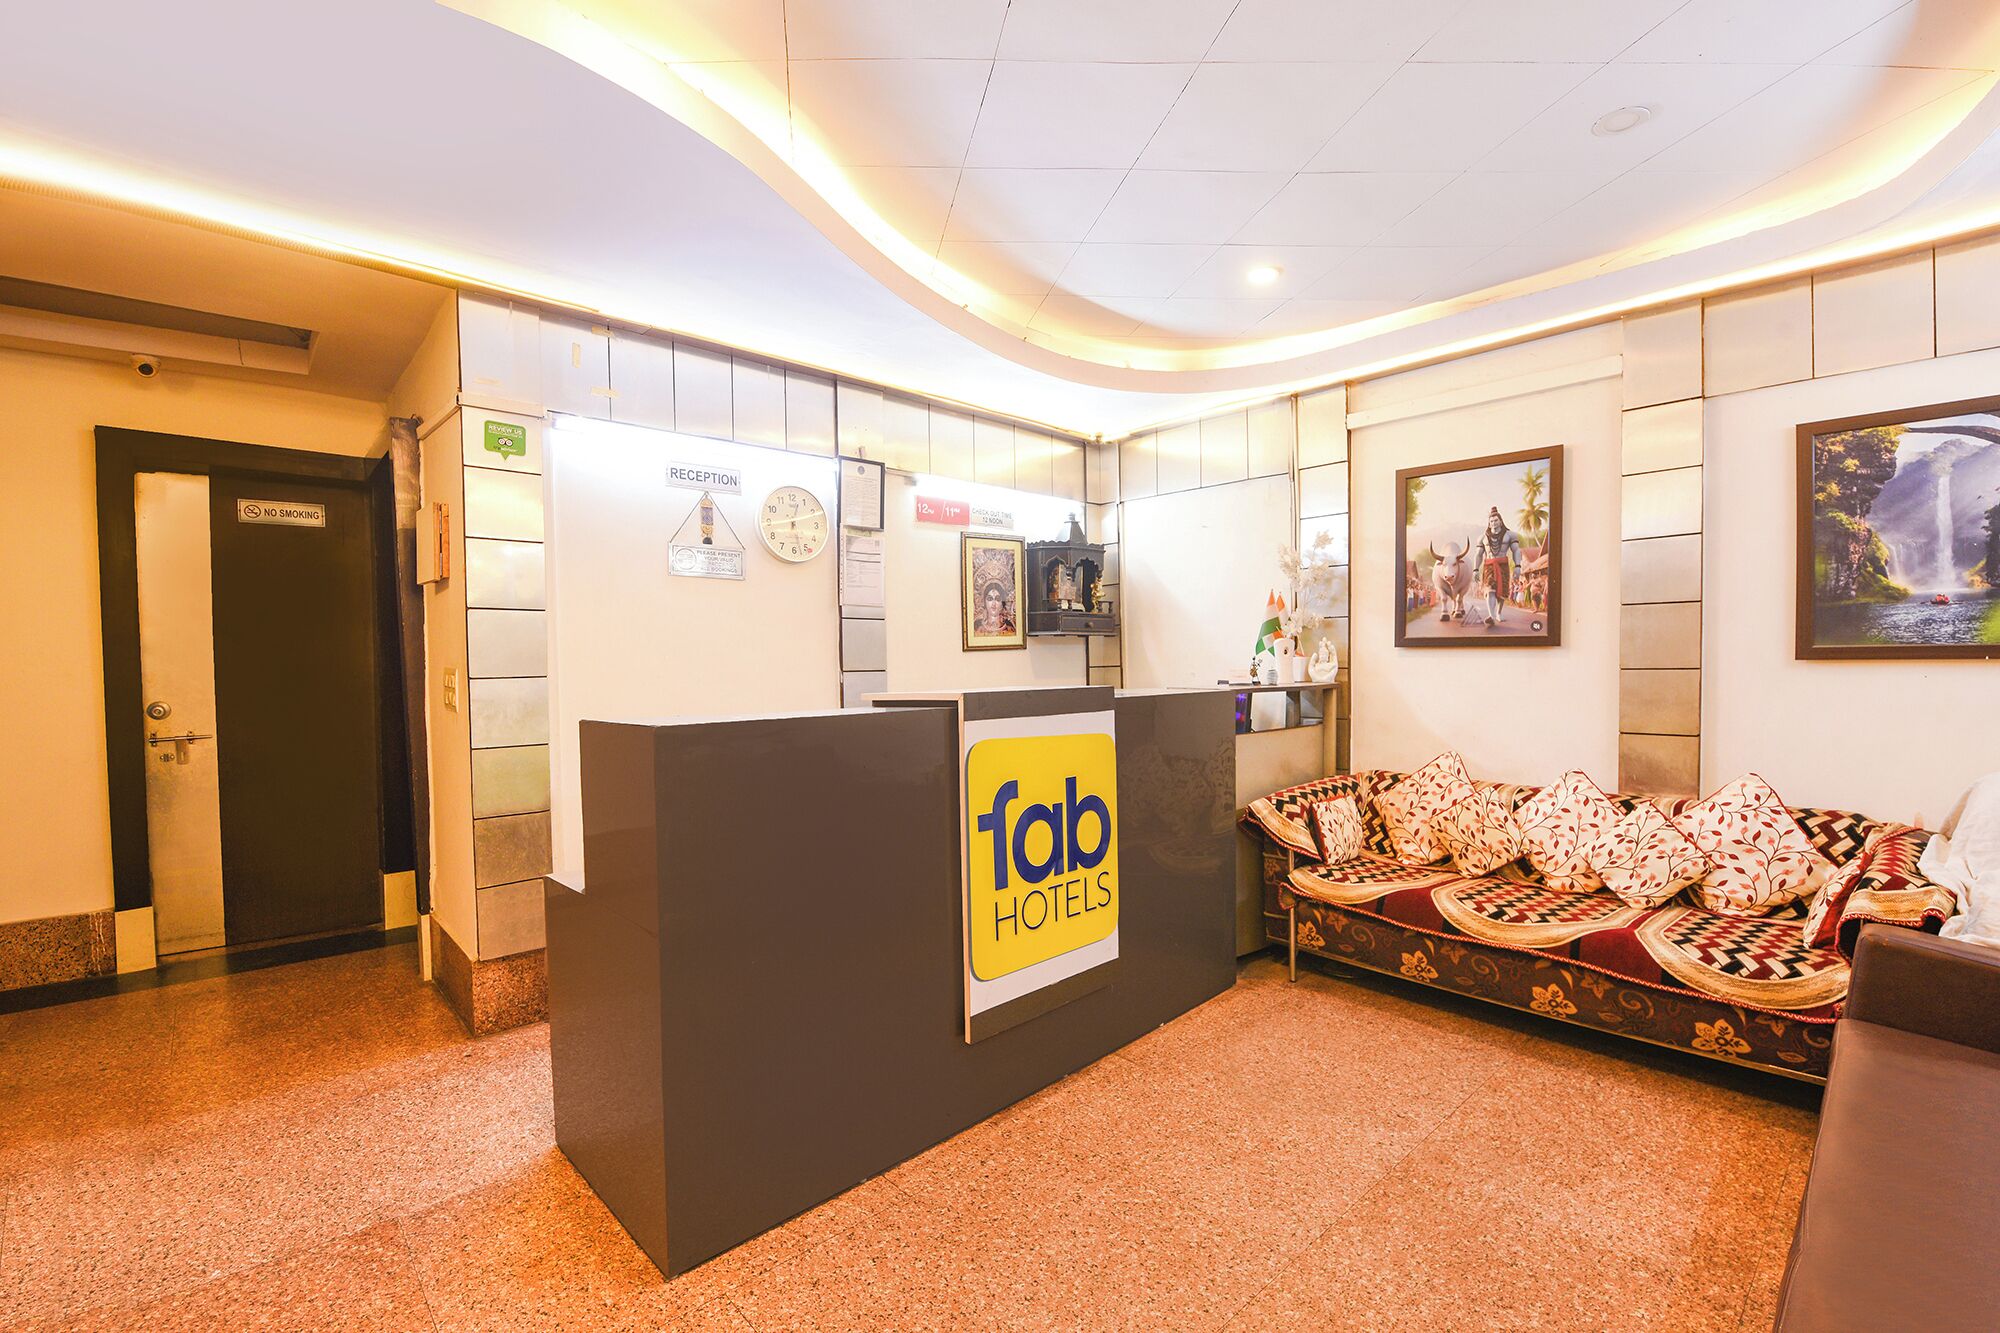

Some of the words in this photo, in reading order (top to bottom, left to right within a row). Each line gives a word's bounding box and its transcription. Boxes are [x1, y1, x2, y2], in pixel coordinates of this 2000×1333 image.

[670, 467, 737, 486] RECEPTION
[777, 496, 784, 504] 11
[788, 493, 796, 502] 12
[264, 508, 277, 517] NO
[280, 509, 319, 519] SMOKING
[768, 505, 777, 513] 10
[814, 522, 819, 530] 3
[770, 532, 776, 540] 8
[779, 542, 785, 550] 7
[803, 543, 808, 552] 5
[978, 776, 1111, 891] fab
[995, 871, 1111, 941] HOTELS
